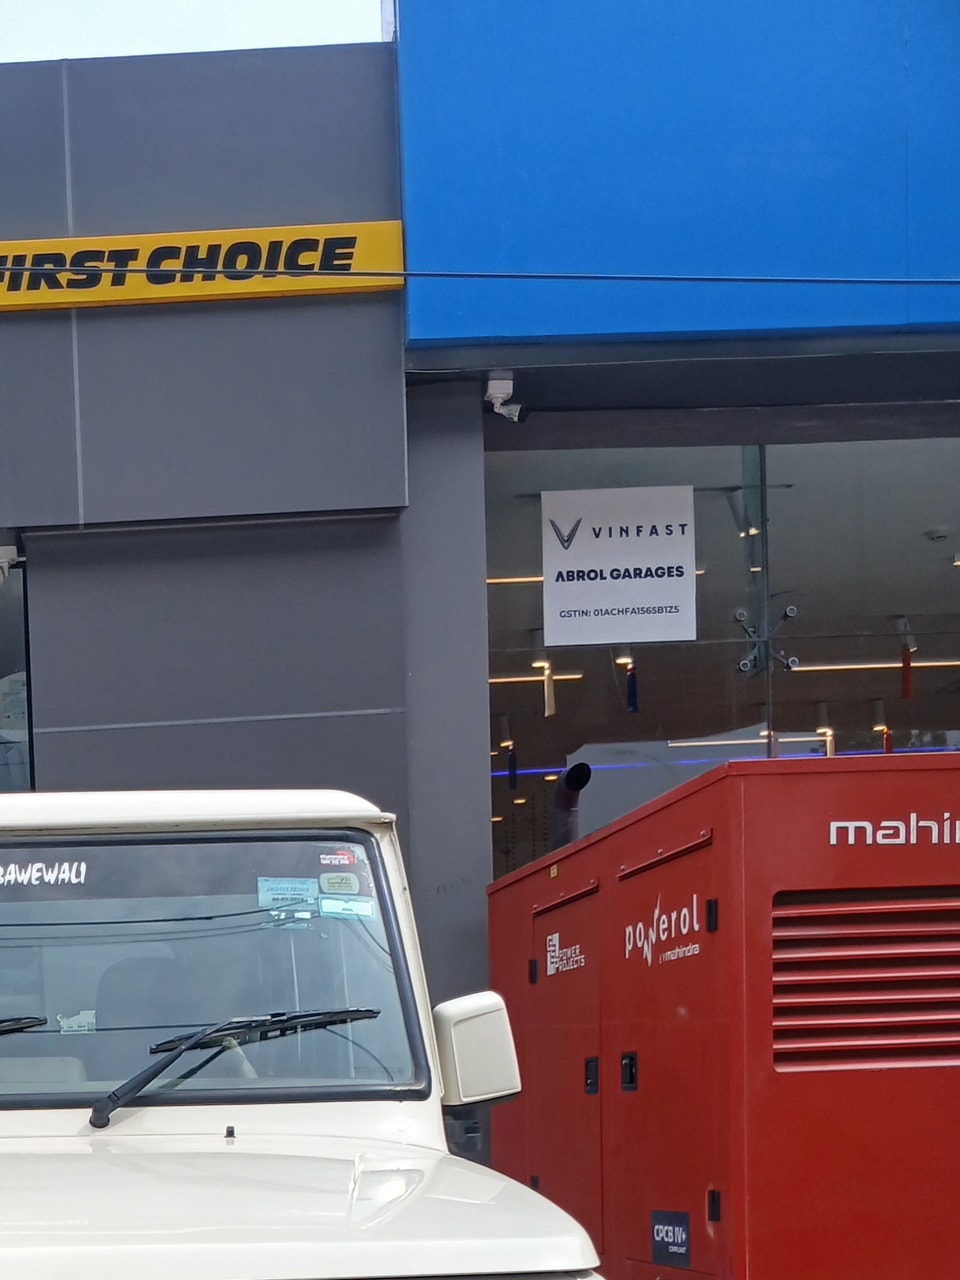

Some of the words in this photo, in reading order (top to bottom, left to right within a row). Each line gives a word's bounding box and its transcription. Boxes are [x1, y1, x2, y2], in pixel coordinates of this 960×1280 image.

[146, 236, 358, 286] CHOICE
[592, 523, 688, 539] VINFAST
[555, 569, 608, 582] ABROL
[609, 565, 685, 580] GARAGES
[559, 608, 591, 618] GSTIN:
[829, 811, 960, 845] mahi
[559, 944, 581, 960] POWER
[559, 955, 586, 973] PROJECTS
[653, 1224, 674, 1243] CPCB
